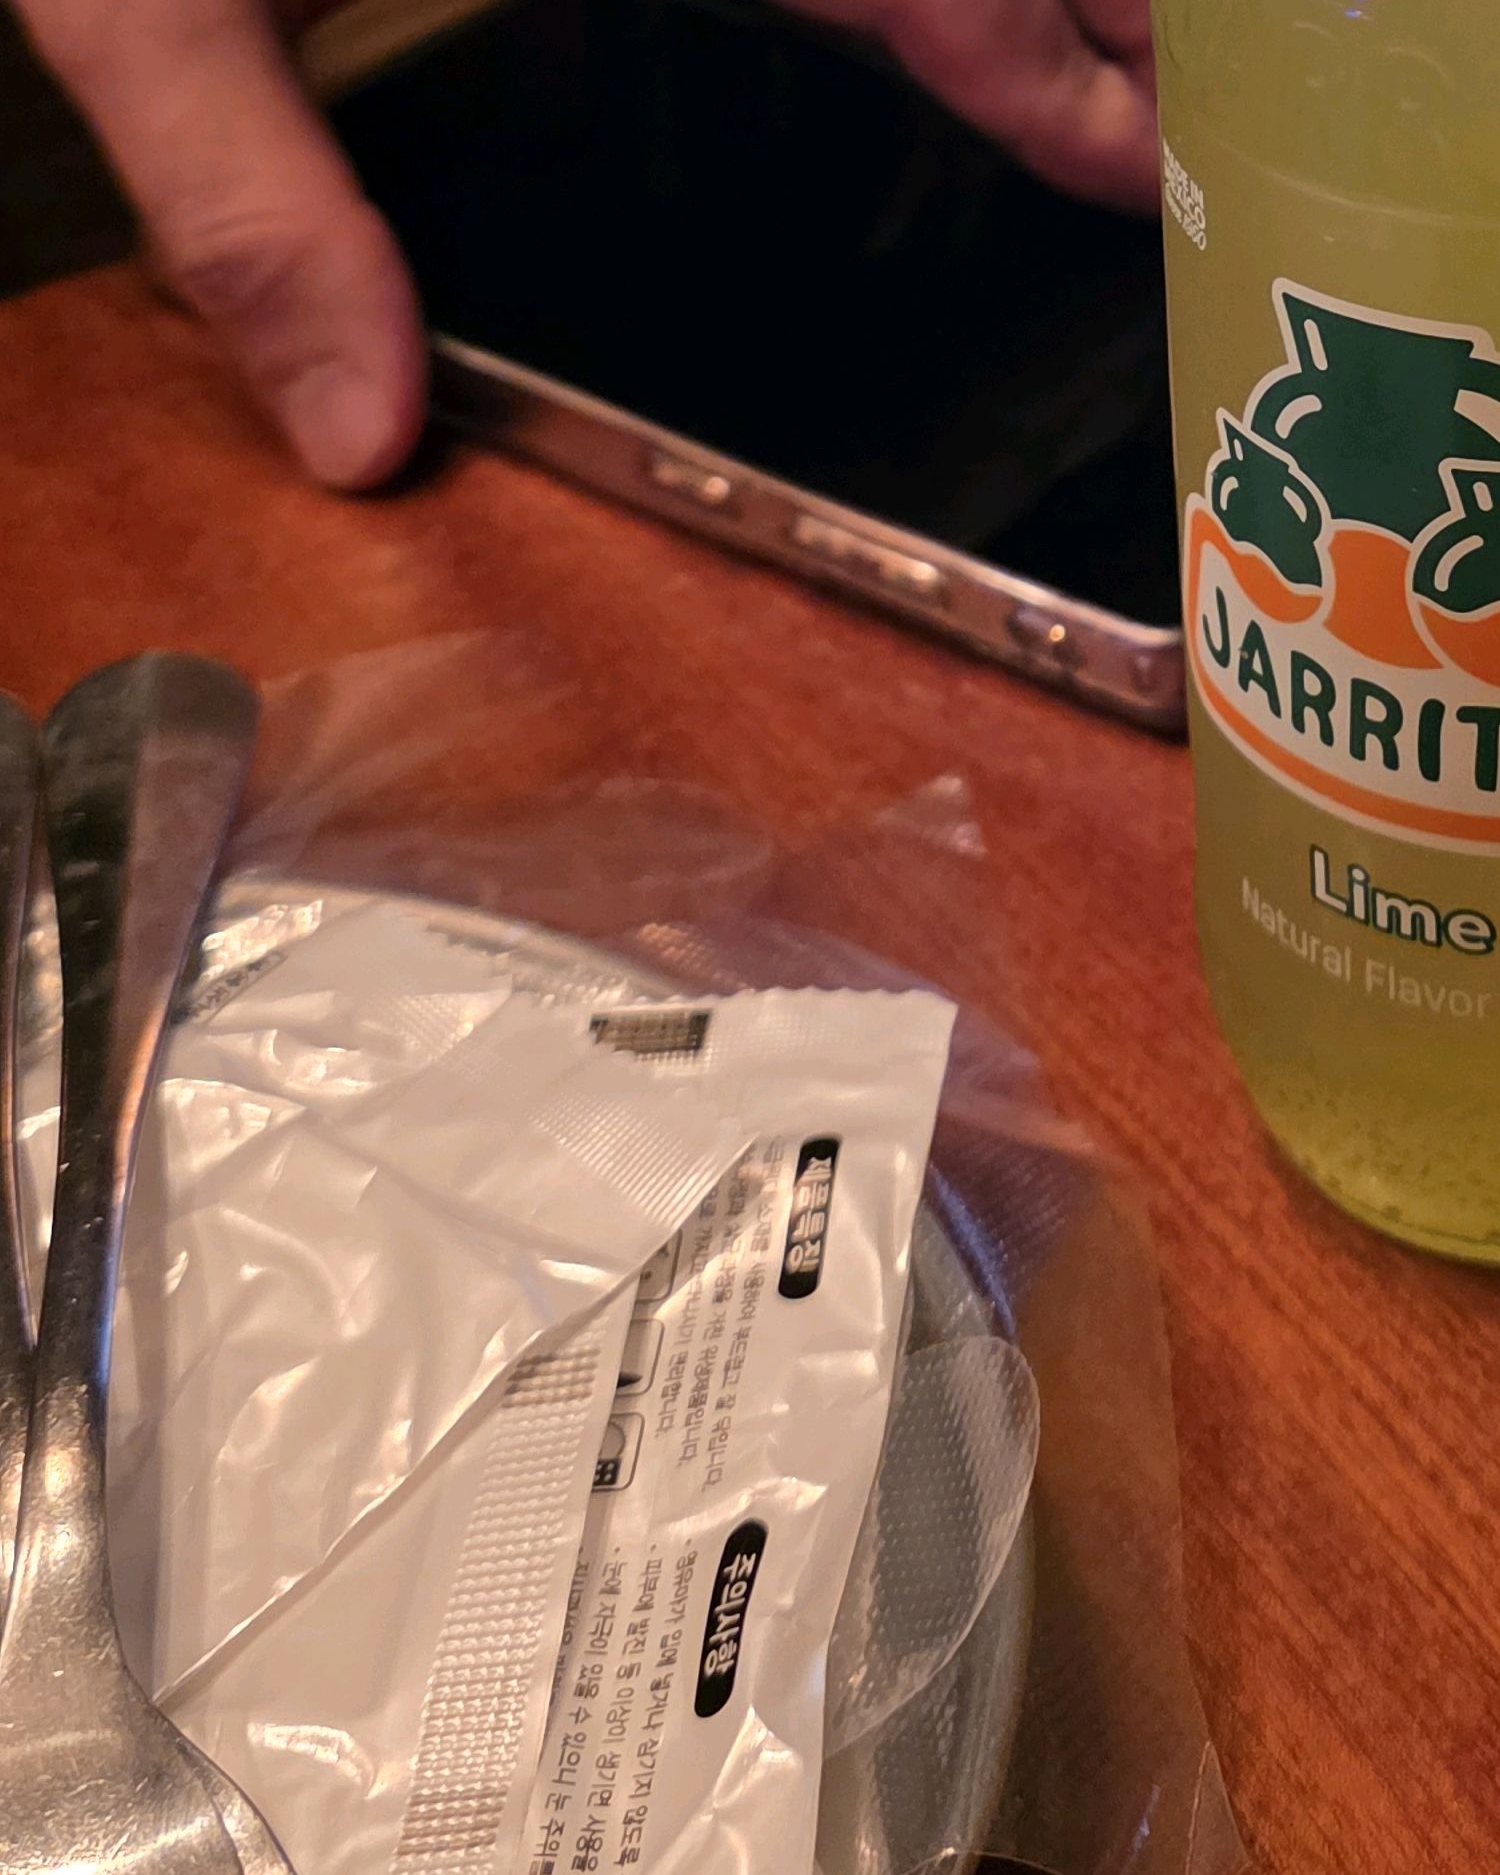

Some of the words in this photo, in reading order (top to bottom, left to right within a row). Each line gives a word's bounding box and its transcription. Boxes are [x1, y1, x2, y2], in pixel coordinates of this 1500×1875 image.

[1308, 844, 1497, 956] Lime
[1241, 876, 1353, 984] Natural
[1364, 957, 1493, 1021] Flavor
[790, 1155, 833, 1275] 제품특징
[603, 1560, 628, 1596] 눈에
[634, 1557, 663, 1612] 피부에
[584, 1602, 617, 1656] 자극이
[622, 1617, 650, 1657] 발진
[705, 1552, 758, 1677] 주의사항
[618, 1661, 642, 1681] 등
[656, 1628, 683, 1668] 입에
[574, 1662, 604, 1700] 있을
[568, 1705, 593, 1726] 수
[602, 1687, 635, 1745] 이상이
[552, 1730, 588, 1787] 있으니
[587, 1750, 622, 1808] 생기면
[545, 1791, 573, 1813] 눈
[571, 1814, 607, 1874] 사용을
[613, 1804, 649, 1868] 않도록
